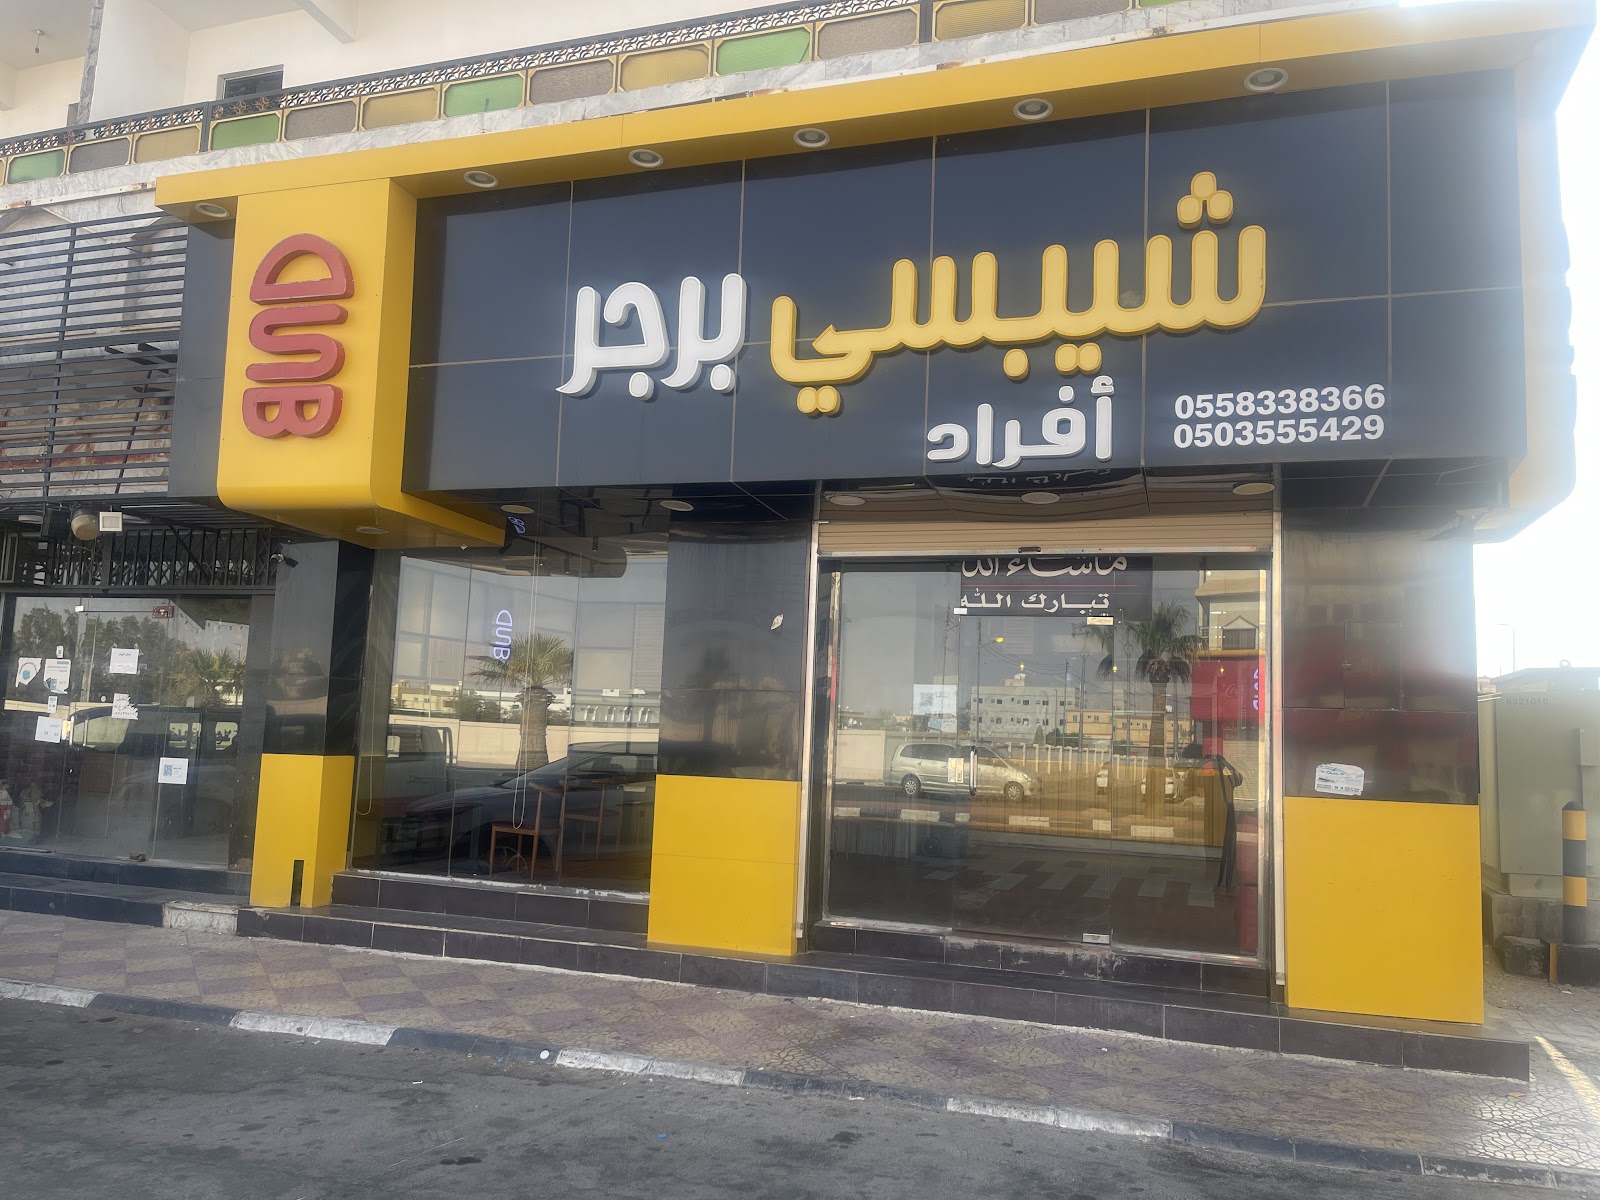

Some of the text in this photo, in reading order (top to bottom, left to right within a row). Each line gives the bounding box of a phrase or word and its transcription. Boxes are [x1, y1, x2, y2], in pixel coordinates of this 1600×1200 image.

[555, 171, 1266, 414] شيبسي برجر
[927, 375, 1115, 468] أفراد
[1173, 414, 1385, 448] 0503555429
[1174, 383, 1386, 420] 0558338366
